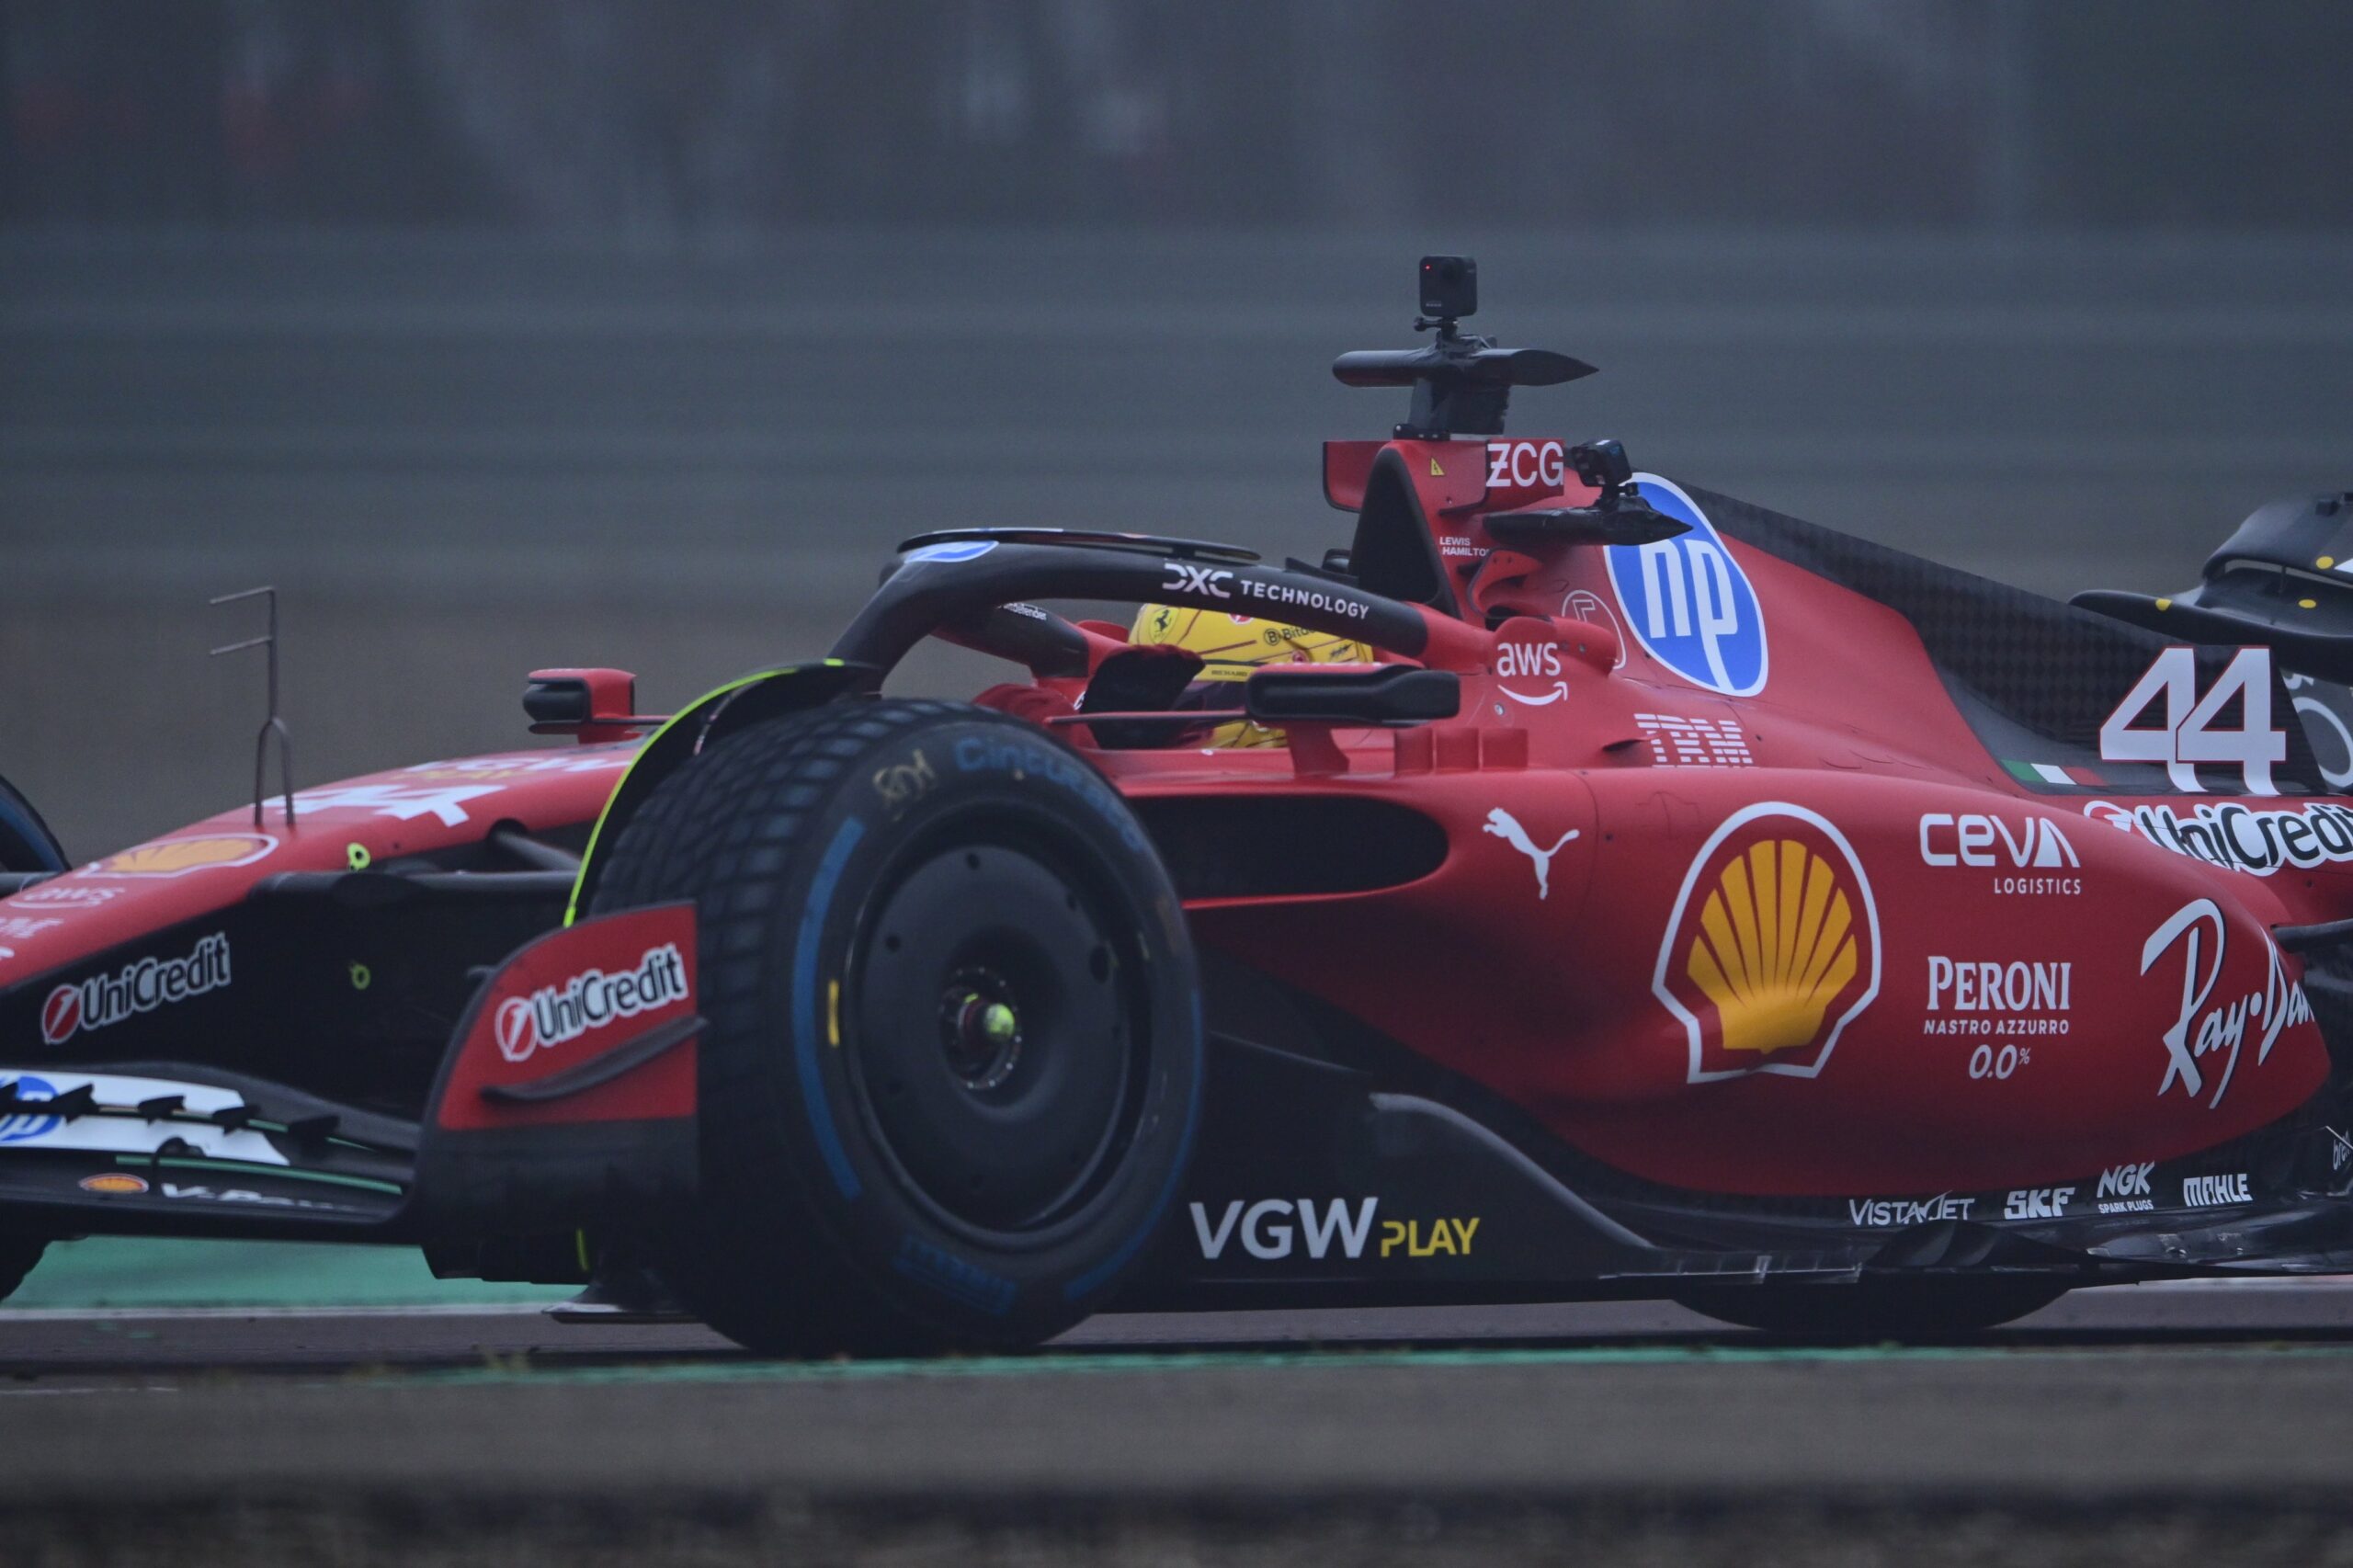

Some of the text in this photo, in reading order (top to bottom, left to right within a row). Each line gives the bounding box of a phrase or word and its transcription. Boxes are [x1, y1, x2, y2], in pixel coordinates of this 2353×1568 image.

[1439, 536, 1471, 547] LEWIS
[1442, 546, 1490, 557] HAMILTO
[1162, 562, 1370, 619] DXC TECHNOLOGY
[1496, 642, 1562, 676] aws
[2099, 644, 2287, 796] 44
[1633, 713, 1754, 768] IBM
[1994, 877, 2082, 895] LOGISTICS
[82, 932, 231, 1029] UniCredit
[532, 945, 688, 1045] UniCredit
[1927, 956, 2072, 1011] PERONI
[1924, 1018, 2070, 1035] NASTRO AZZURRO
[1969, 1044, 2031, 1080] 0.0%
[2097, 1161, 2155, 1199] NGK
[2183, 1173, 2254, 1207] MAHLE
[1848, 1189, 1975, 1226] VISTAJET
[2004, 1187, 2075, 1221] SKF
[2097, 1199, 2154, 1215] SPARK PLUGS
[1189, 1196, 1481, 1260] VGW PLAY
